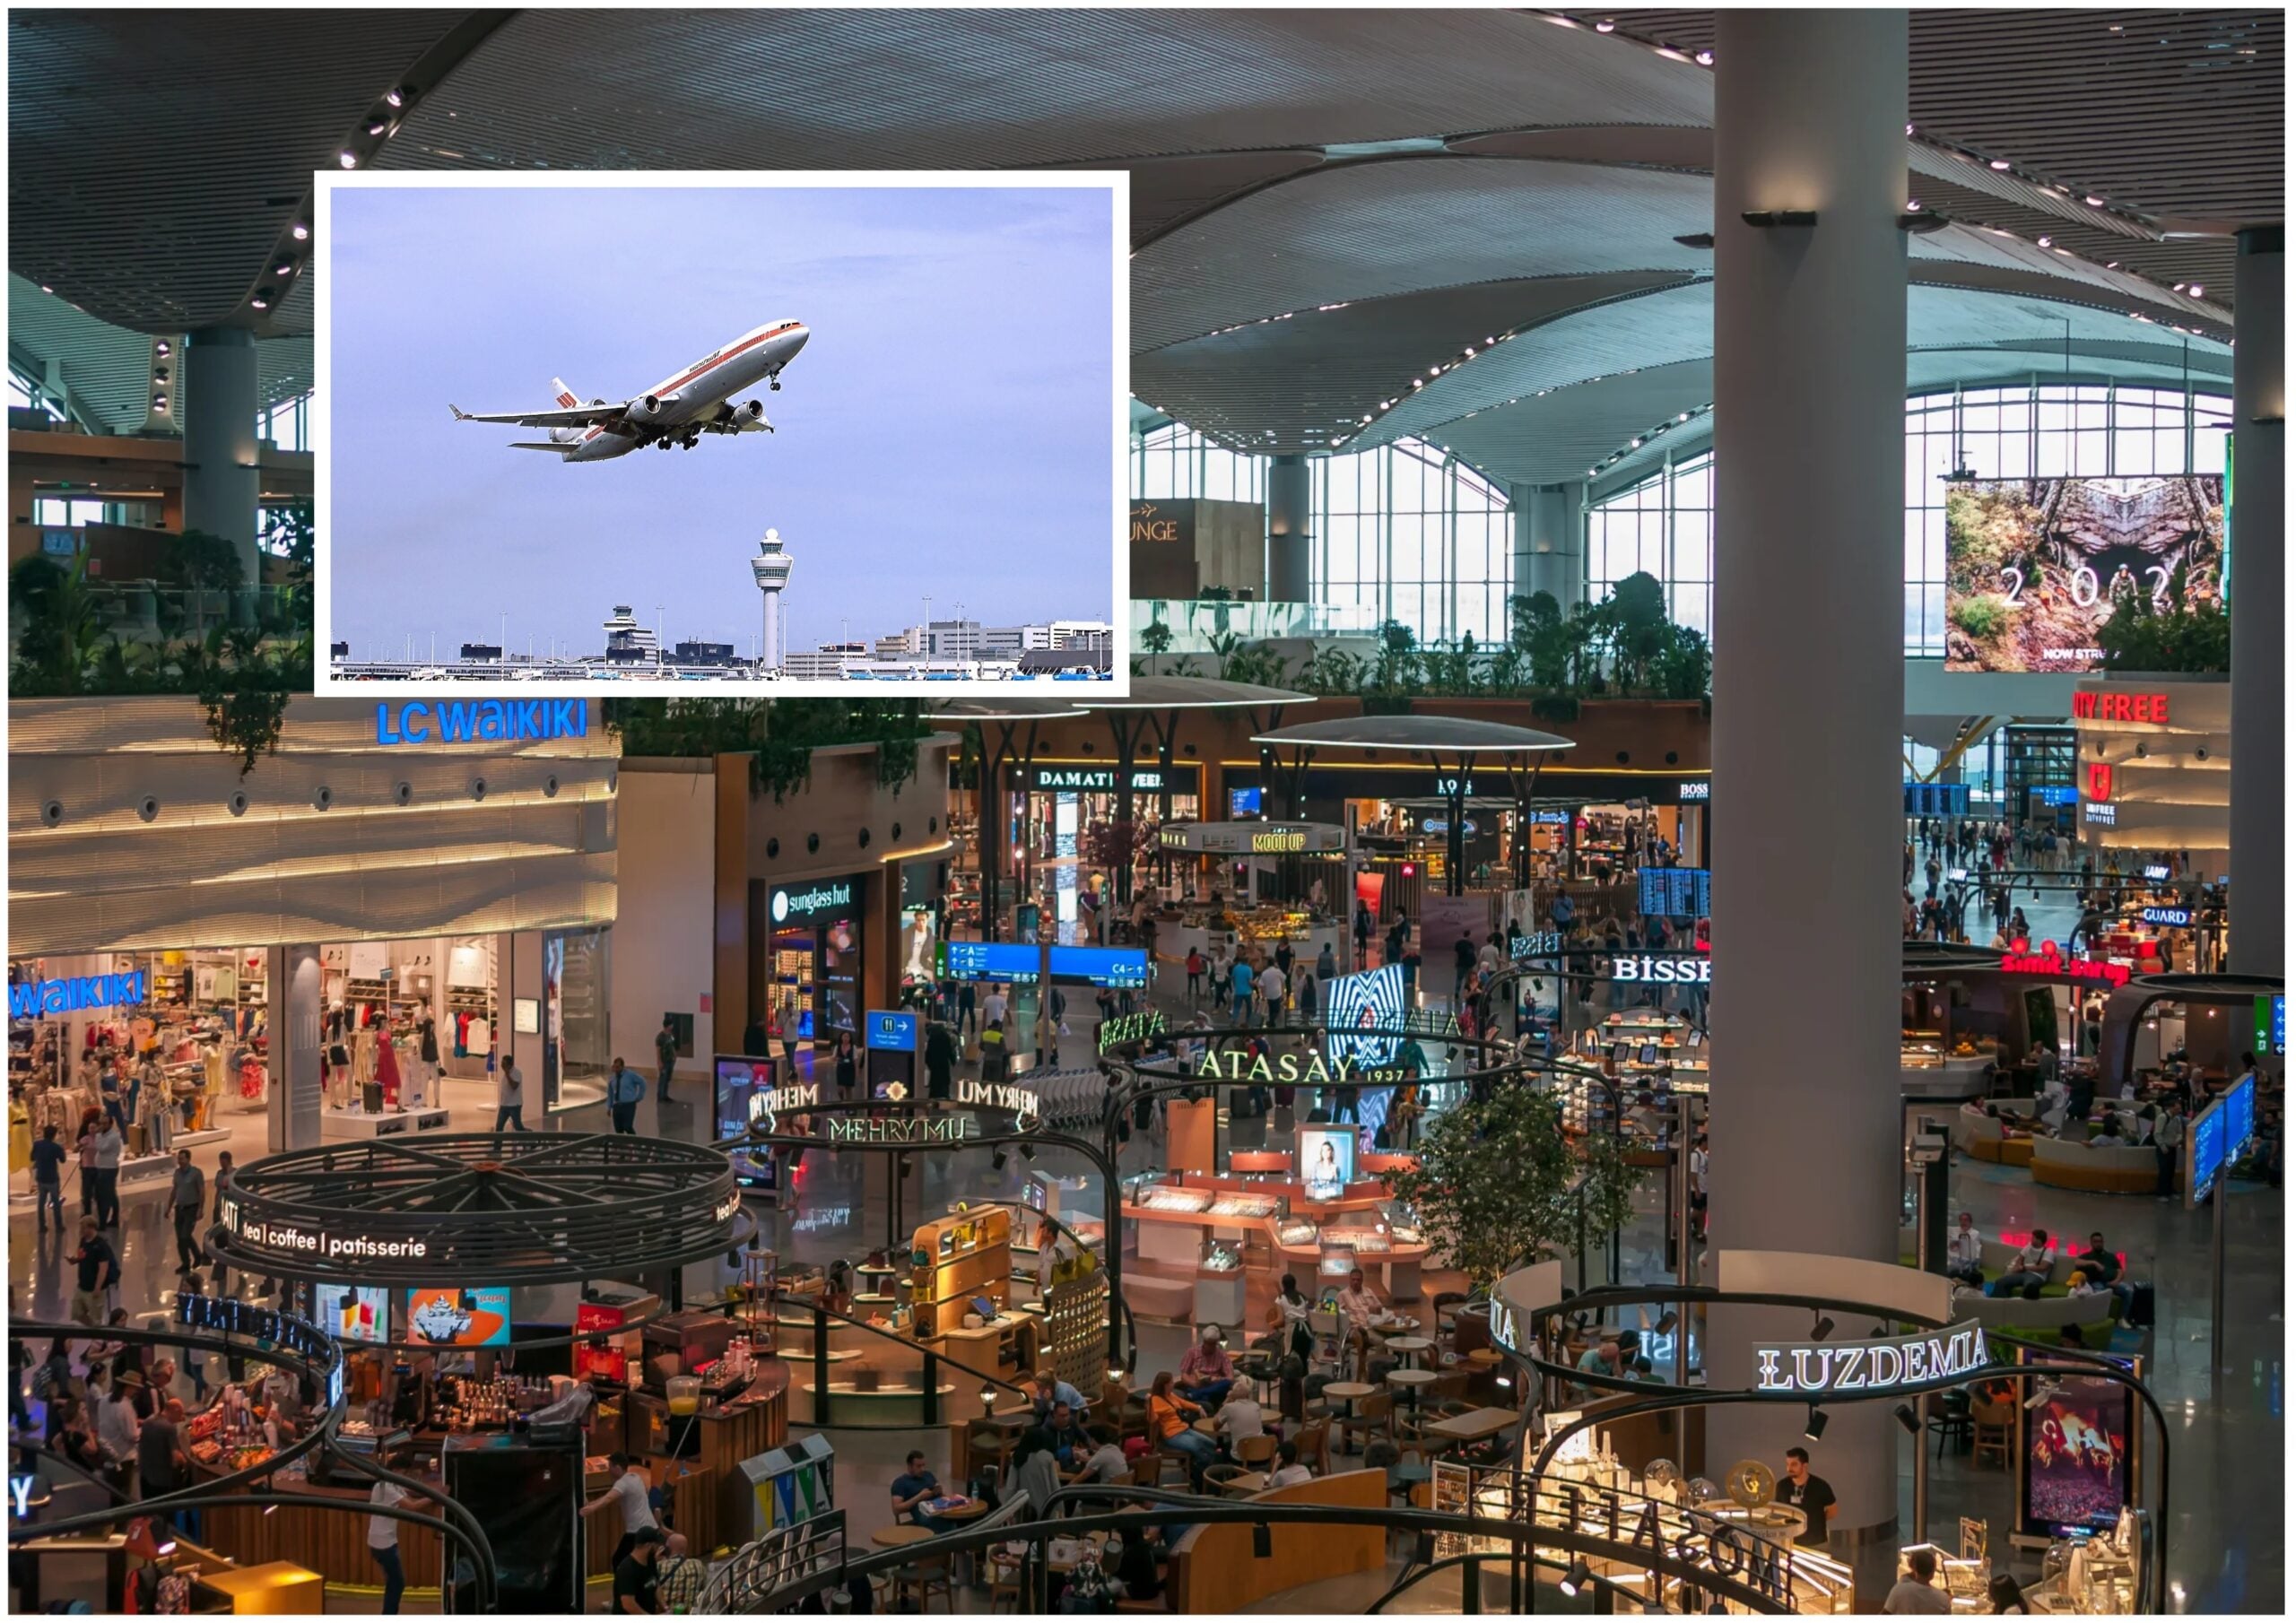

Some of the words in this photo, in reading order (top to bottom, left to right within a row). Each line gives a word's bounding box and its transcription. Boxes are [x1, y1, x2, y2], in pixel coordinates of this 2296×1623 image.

[2043, 648, 2073, 659] NOW
[2101, 693, 2168, 723] FREE
[378, 702, 430, 745] LC
[1039, 772, 1107, 786] DAMAT
[1680, 783, 1709, 794] BOSS
[1252, 834, 1286, 852] MOOD
[1289, 833, 1306, 851] UP
[789, 887, 831, 915] sunglass
[833, 883, 850, 905] hut
[2144, 907, 2187, 924] GUARD
[968, 946, 975, 956] A
[968, 957, 974, 968] B
[1112, 963, 1126, 974] C4
[1197, 1050, 1355, 1082] ATASAY
[1367, 1070, 1405, 1082] 1937
[827, 1117, 918, 1141] MEHRY
[923, 1117, 966, 1141] MU
[243, 1221, 260, 1241] tea
[269, 1228, 316, 1251] coffee
[329, 1236, 426, 1257] patisserie
[1758, 1327, 1987, 1390] LUZDEMIA
